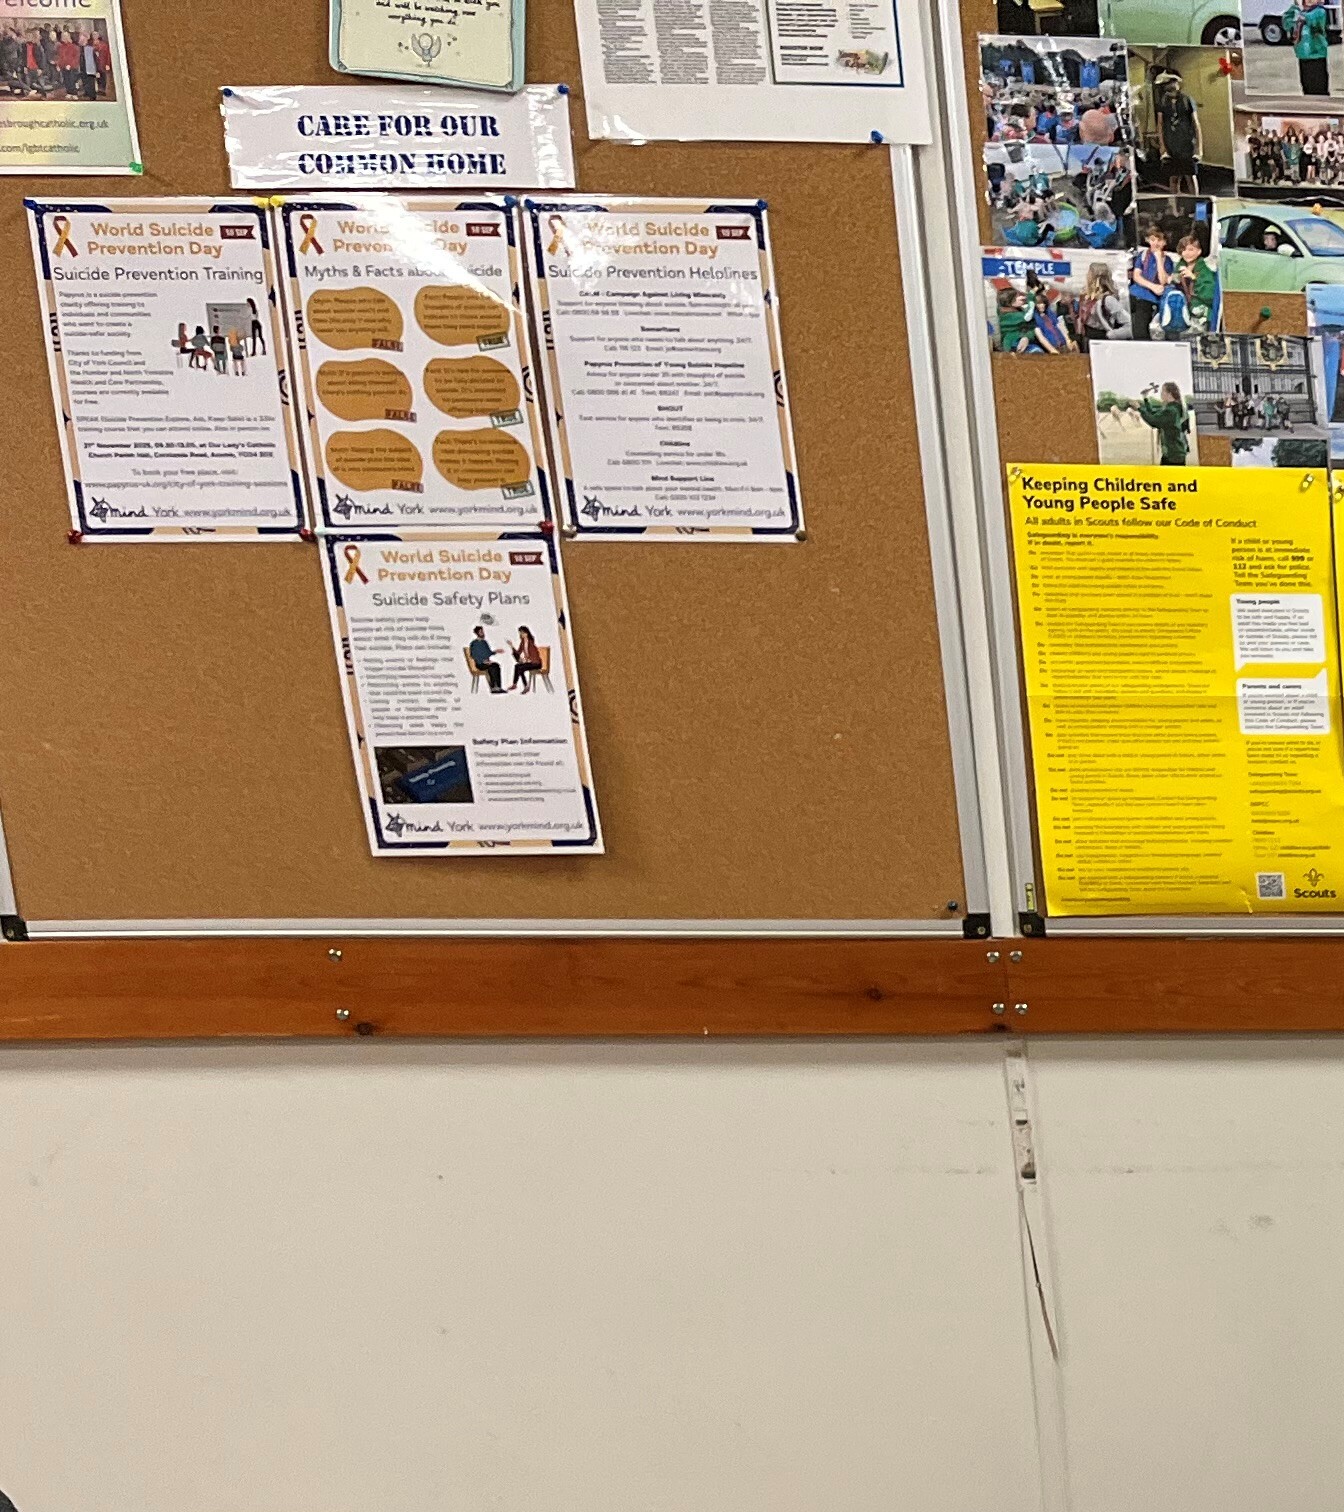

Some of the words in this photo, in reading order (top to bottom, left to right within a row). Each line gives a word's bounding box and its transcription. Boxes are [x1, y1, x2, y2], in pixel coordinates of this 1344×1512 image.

[297, 115, 371, 137] CARE
[377, 115, 434, 137] FOR
[440, 115, 500, 137] OUR
[297, 153, 416, 175] COMMON
[425, 153, 507, 175] HOME
[90, 222, 144, 237] World
[148, 222, 215, 237] Suicide
[645, 222, 711, 237] Suicide
[87, 241, 186, 256] Prevention
[190, 242, 223, 258] Day
[685, 242, 719, 259] Day
[53, 266, 110, 281] Suicide
[115, 266, 200, 281] Prevention
[203, 266, 264, 284] Training
[304, 265, 349, 282] Myths
[353, 265, 363, 278] &
[365, 265, 405, 278] Facts
[606, 265, 687, 280] Prevention
[1021, 476, 1089, 494] Keeping
[1093, 477, 1163, 493] Children
[1167, 479, 1198, 493] and
[153, 506, 180, 517] York
[399, 504, 425, 515] York
[645, 505, 673, 517] York
[1022, 495, 1075, 512] Young
[1079, 496, 1136, 513] People
[1140, 497, 1177, 511] Safe
[1025, 516, 1039, 526] All
[1041, 516, 1072, 526] adults
[1085, 516, 1120, 527] Scouts
[1122, 517, 1153, 527] follow
[1174, 518, 1200, 528] Code
[1215, 518, 1257, 529] Conduct
[380, 549, 434, 564] World
[438, 549, 503, 564] Suicide
[377, 567, 474, 582] Prevention
[478, 568, 512, 584] Day
[372, 592, 429, 607] Suicide
[432, 592, 484, 609] Safety
[488, 591, 531, 605] Plans
[447, 822, 475, 833] York
[1293, 887, 1337, 899] Scouts
